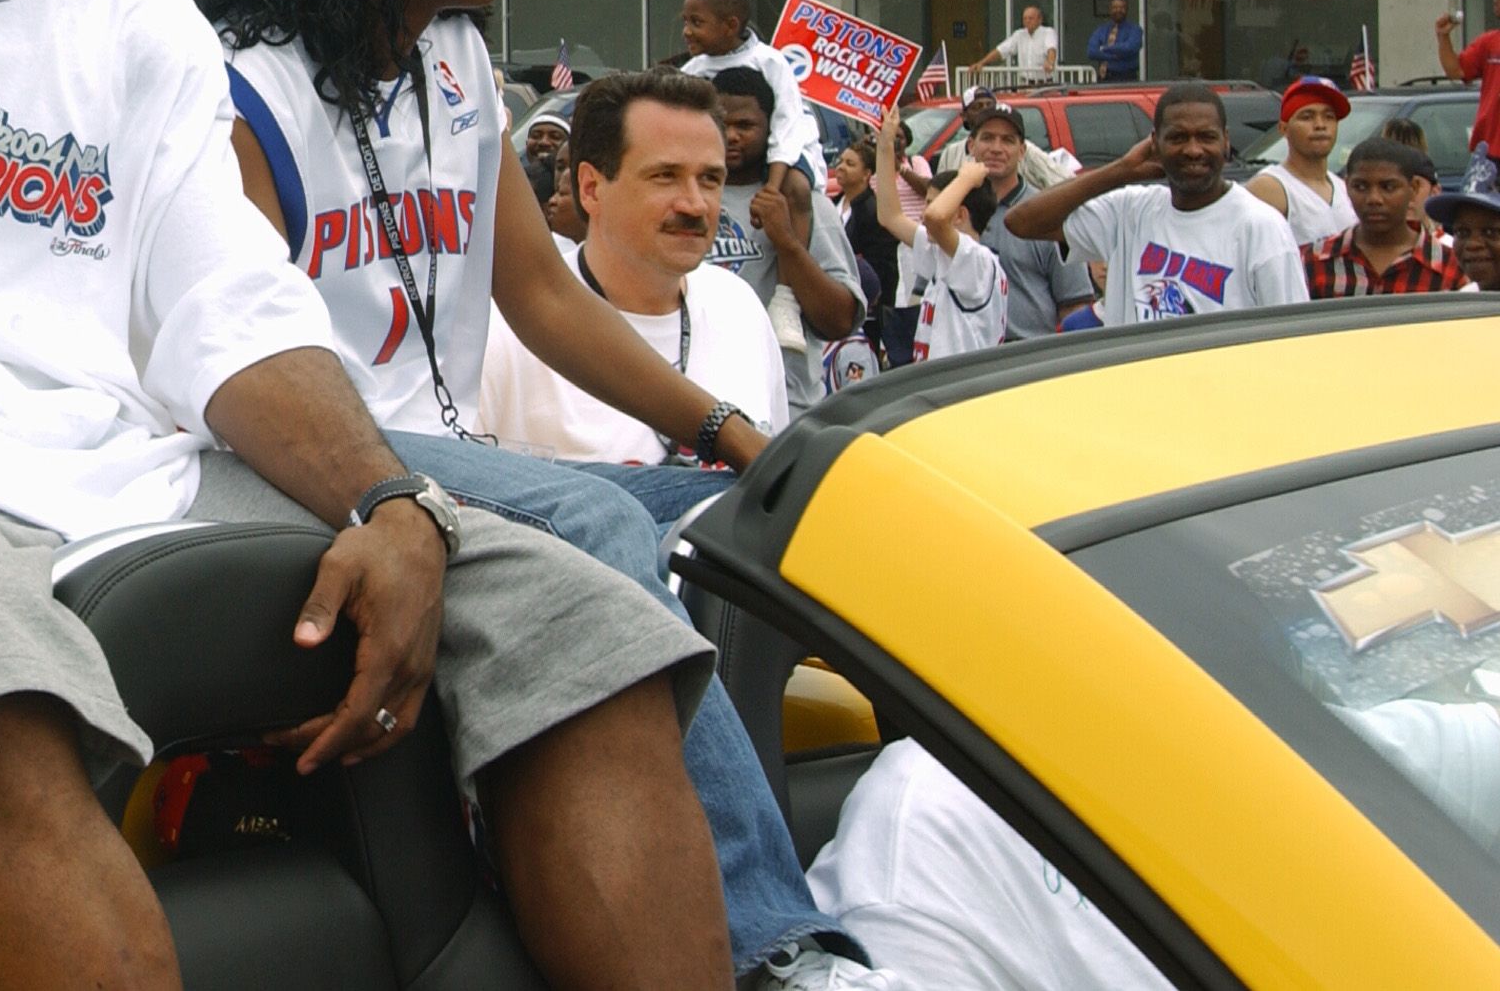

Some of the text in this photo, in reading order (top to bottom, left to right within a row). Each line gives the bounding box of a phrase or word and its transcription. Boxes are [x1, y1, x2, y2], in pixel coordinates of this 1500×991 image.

[790, 0, 912, 68] PISTONS
[812, 34, 902, 86] ROCK THE
[814, 55, 893, 102] WORLD!
[835, 86, 882, 118] Rock
[378, 201, 402, 250] PISTONS
[712, 236, 762, 258] TONS
